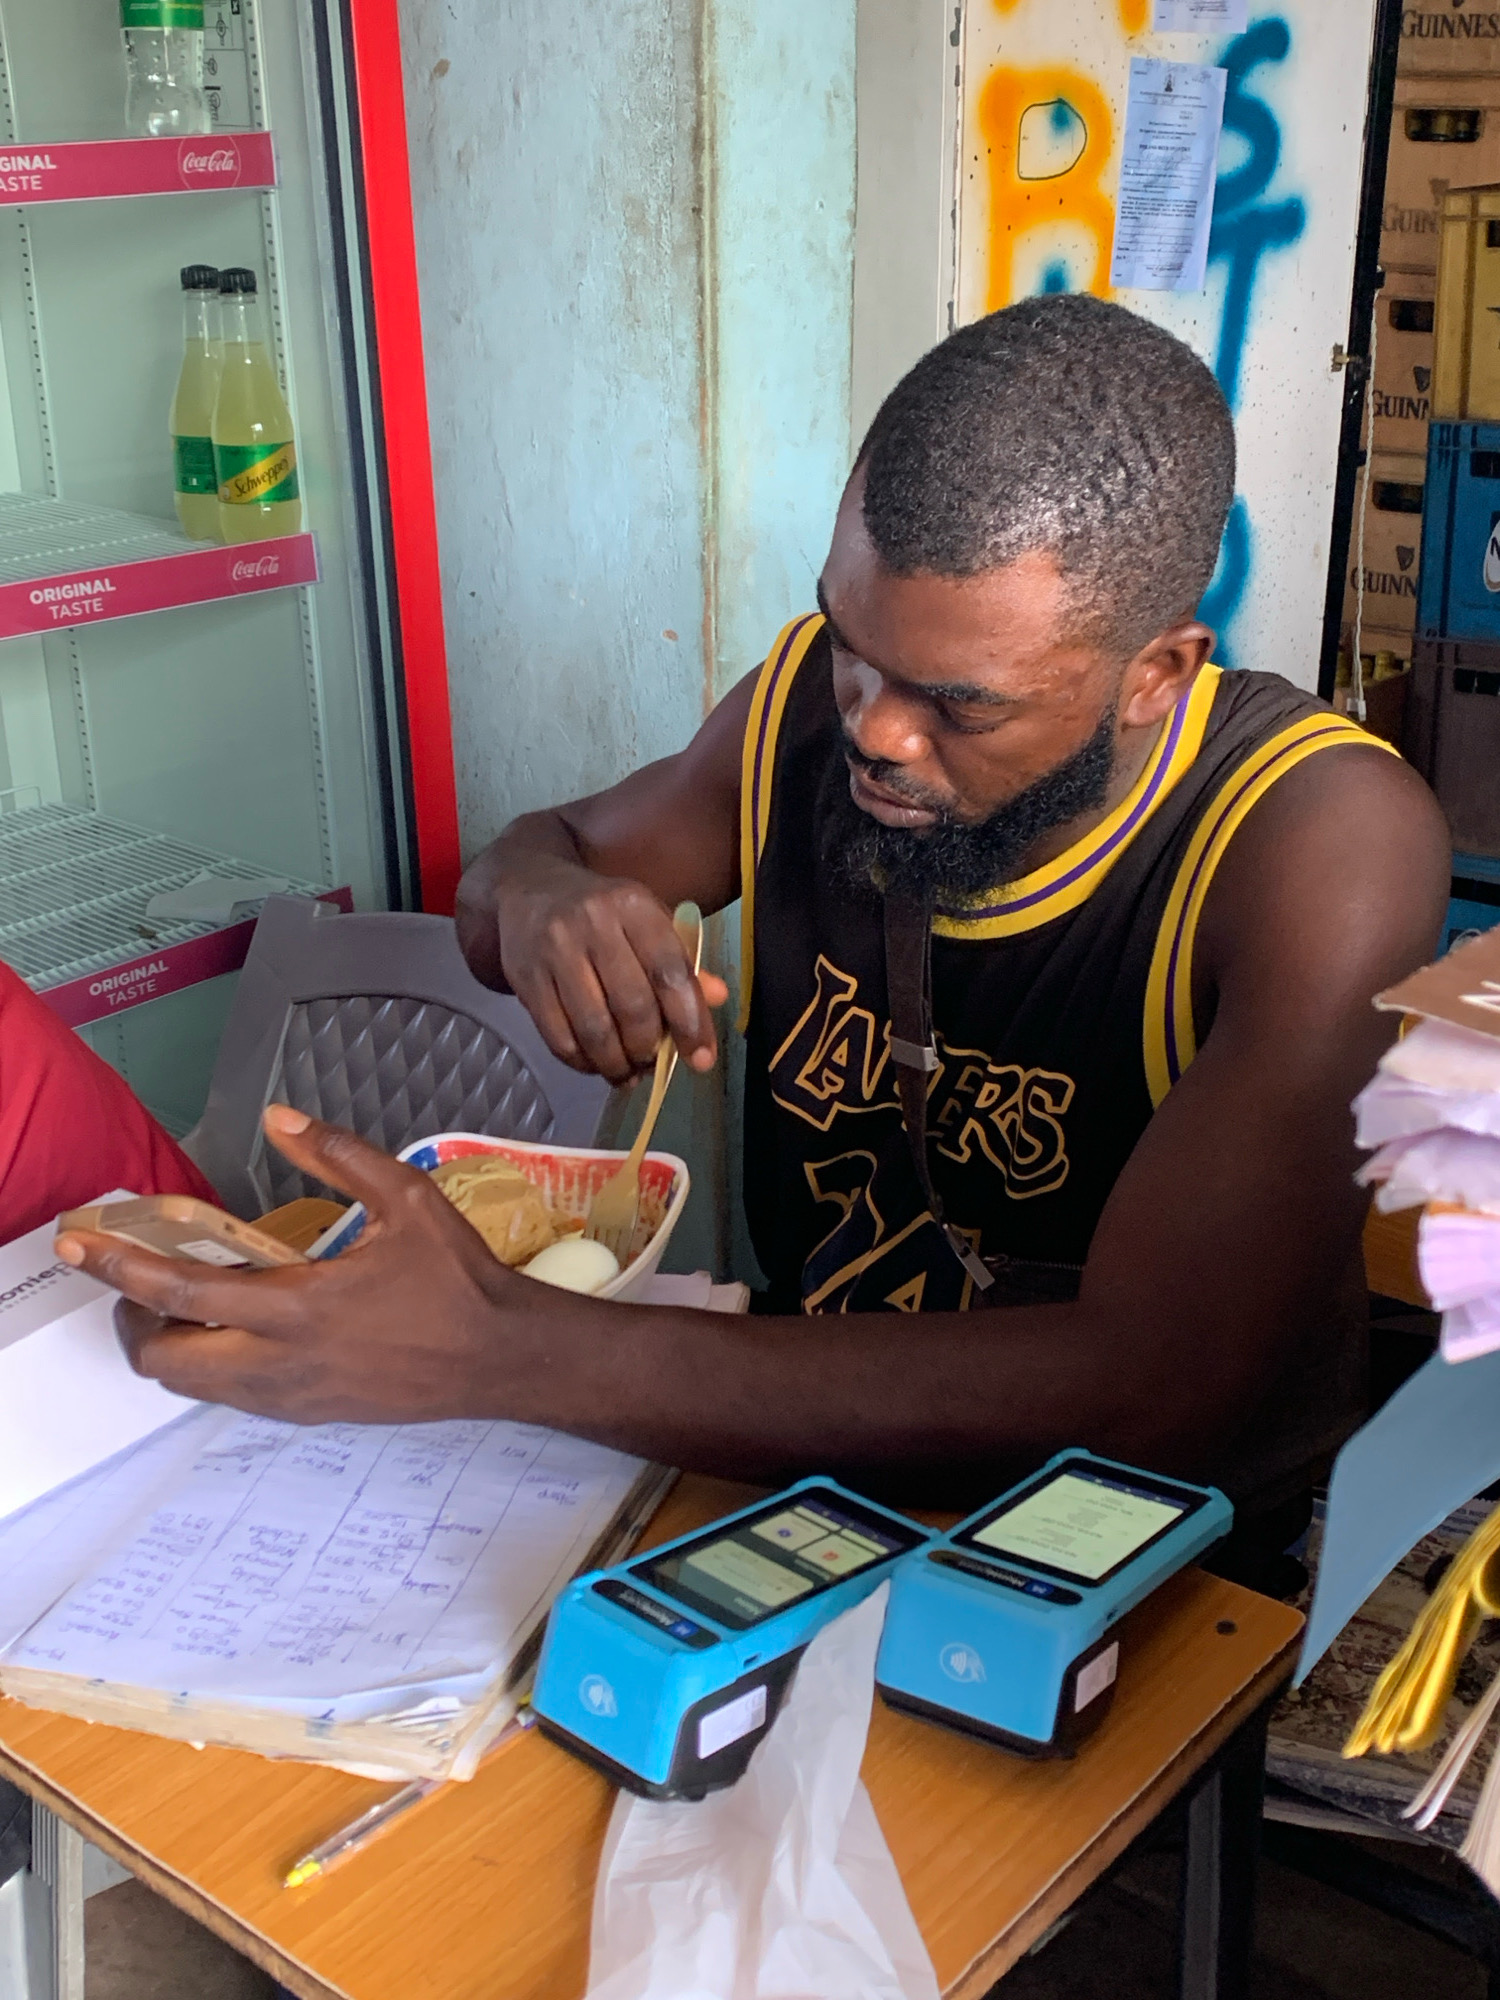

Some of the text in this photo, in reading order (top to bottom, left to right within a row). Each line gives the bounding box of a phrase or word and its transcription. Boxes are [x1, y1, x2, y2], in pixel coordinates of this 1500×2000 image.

[182, 149, 237, 174] Coca-Cola
[1382, 203, 1439, 234] GUIN
[232, 555, 280, 581] Coca-Cola
[29, 577, 116, 605] ORIGINAL
[49, 597, 104, 620] TASTE
[89, 960, 170, 996] ORIGINAL
[106, 979, 157, 1006] TASTE
